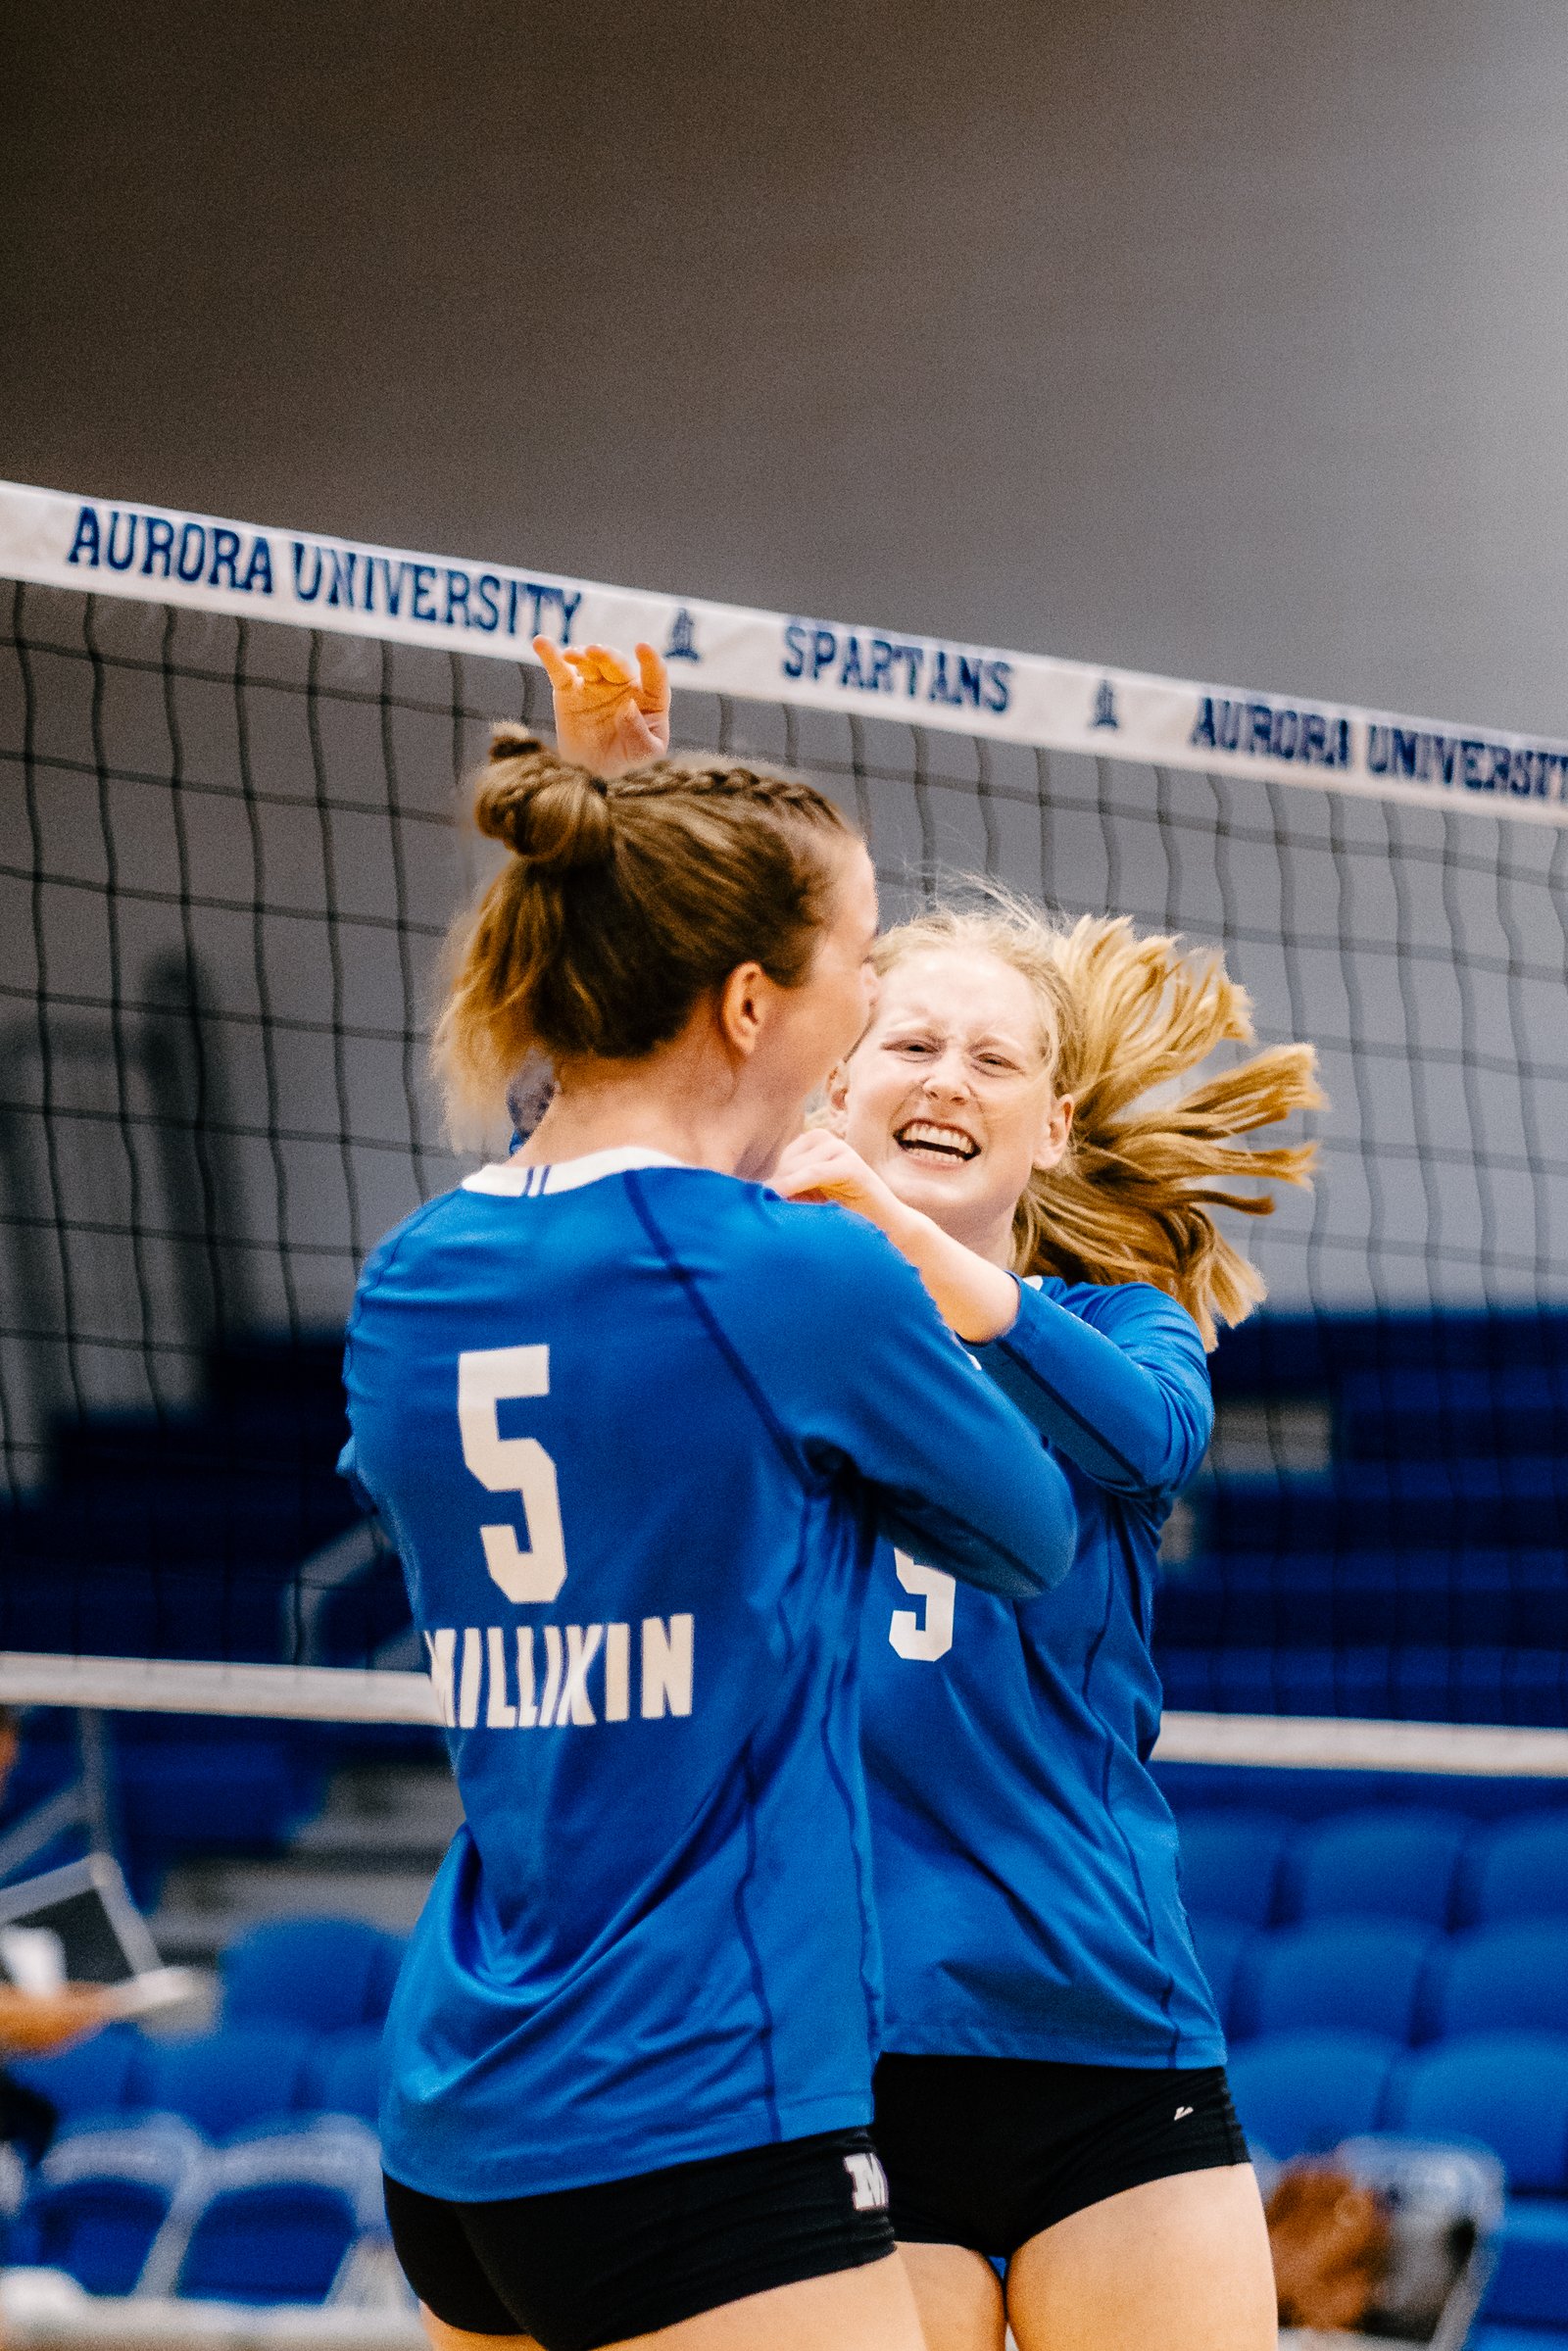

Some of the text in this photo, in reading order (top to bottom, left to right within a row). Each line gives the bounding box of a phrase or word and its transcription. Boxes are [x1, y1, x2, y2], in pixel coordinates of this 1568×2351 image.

[68, 505, 582, 646] AURORA UNIVERSITY
[783, 625, 1013, 713] SPARTANS
[1188, 697, 1348, 768] AURORA
[458, 1344, 567, 1604] 5
